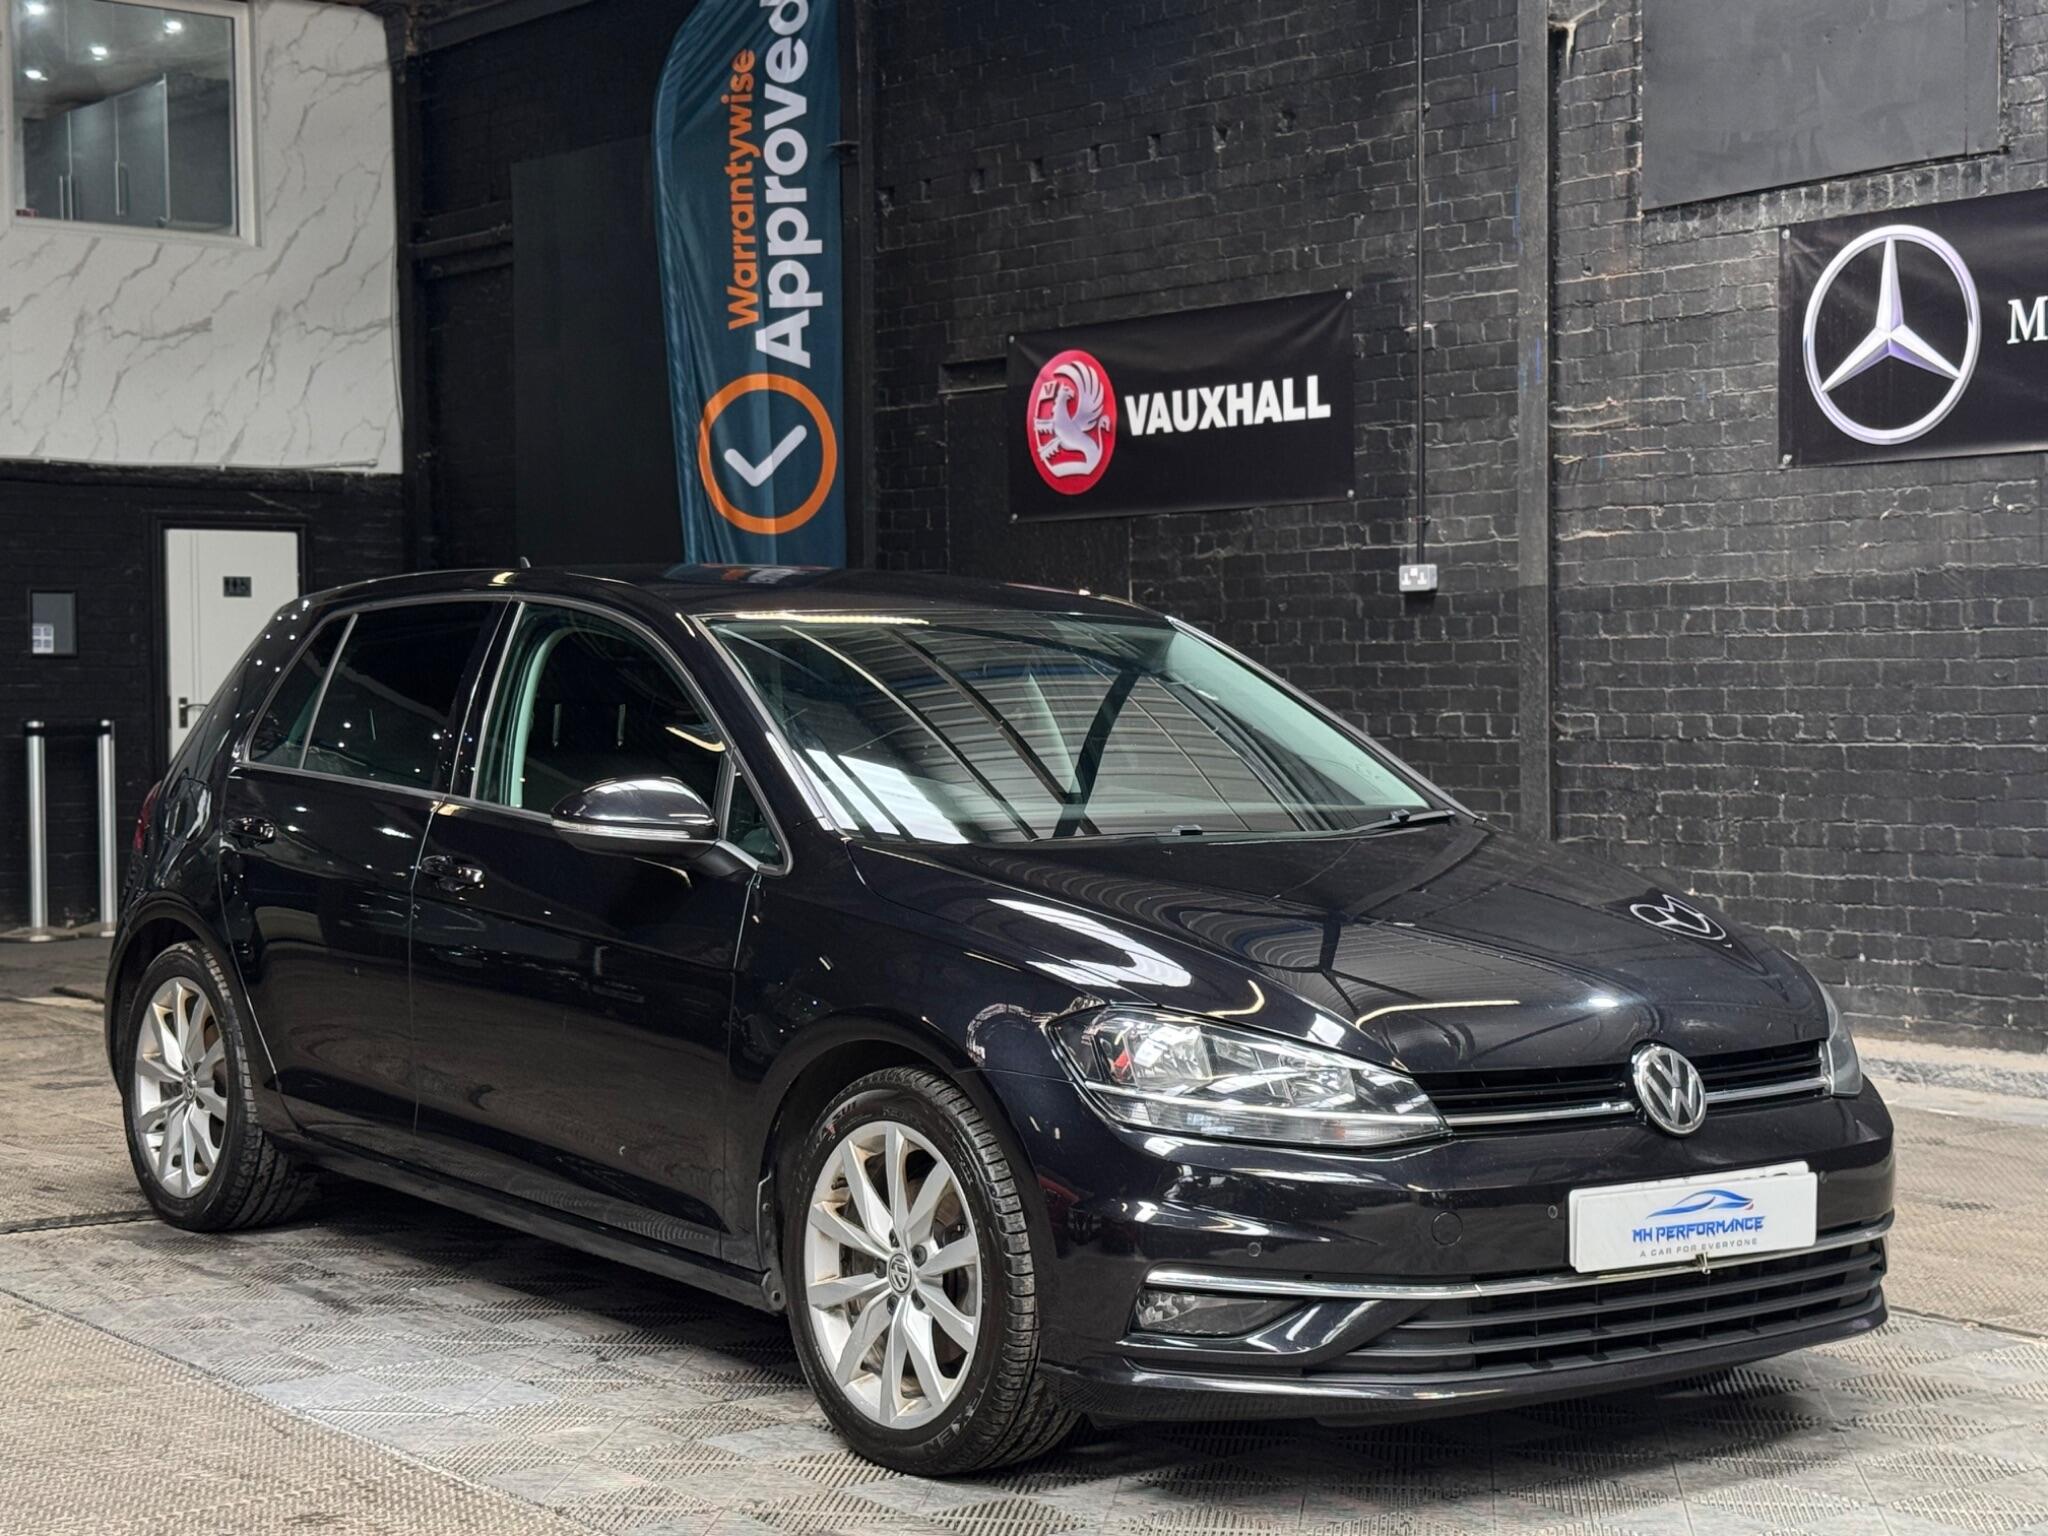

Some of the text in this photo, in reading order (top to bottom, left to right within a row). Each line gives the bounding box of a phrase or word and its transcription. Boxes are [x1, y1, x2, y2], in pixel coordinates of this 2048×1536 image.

[721, 48, 761, 330] Warrantywise
[756, 0, 823, 368] Approved
[1124, 374, 1332, 436] VAUXHALL
[1632, 1216, 1766, 1243] MH PERFORMANCE
[1640, 1238, 1758, 1258] A CAR FOR EVERYONE
